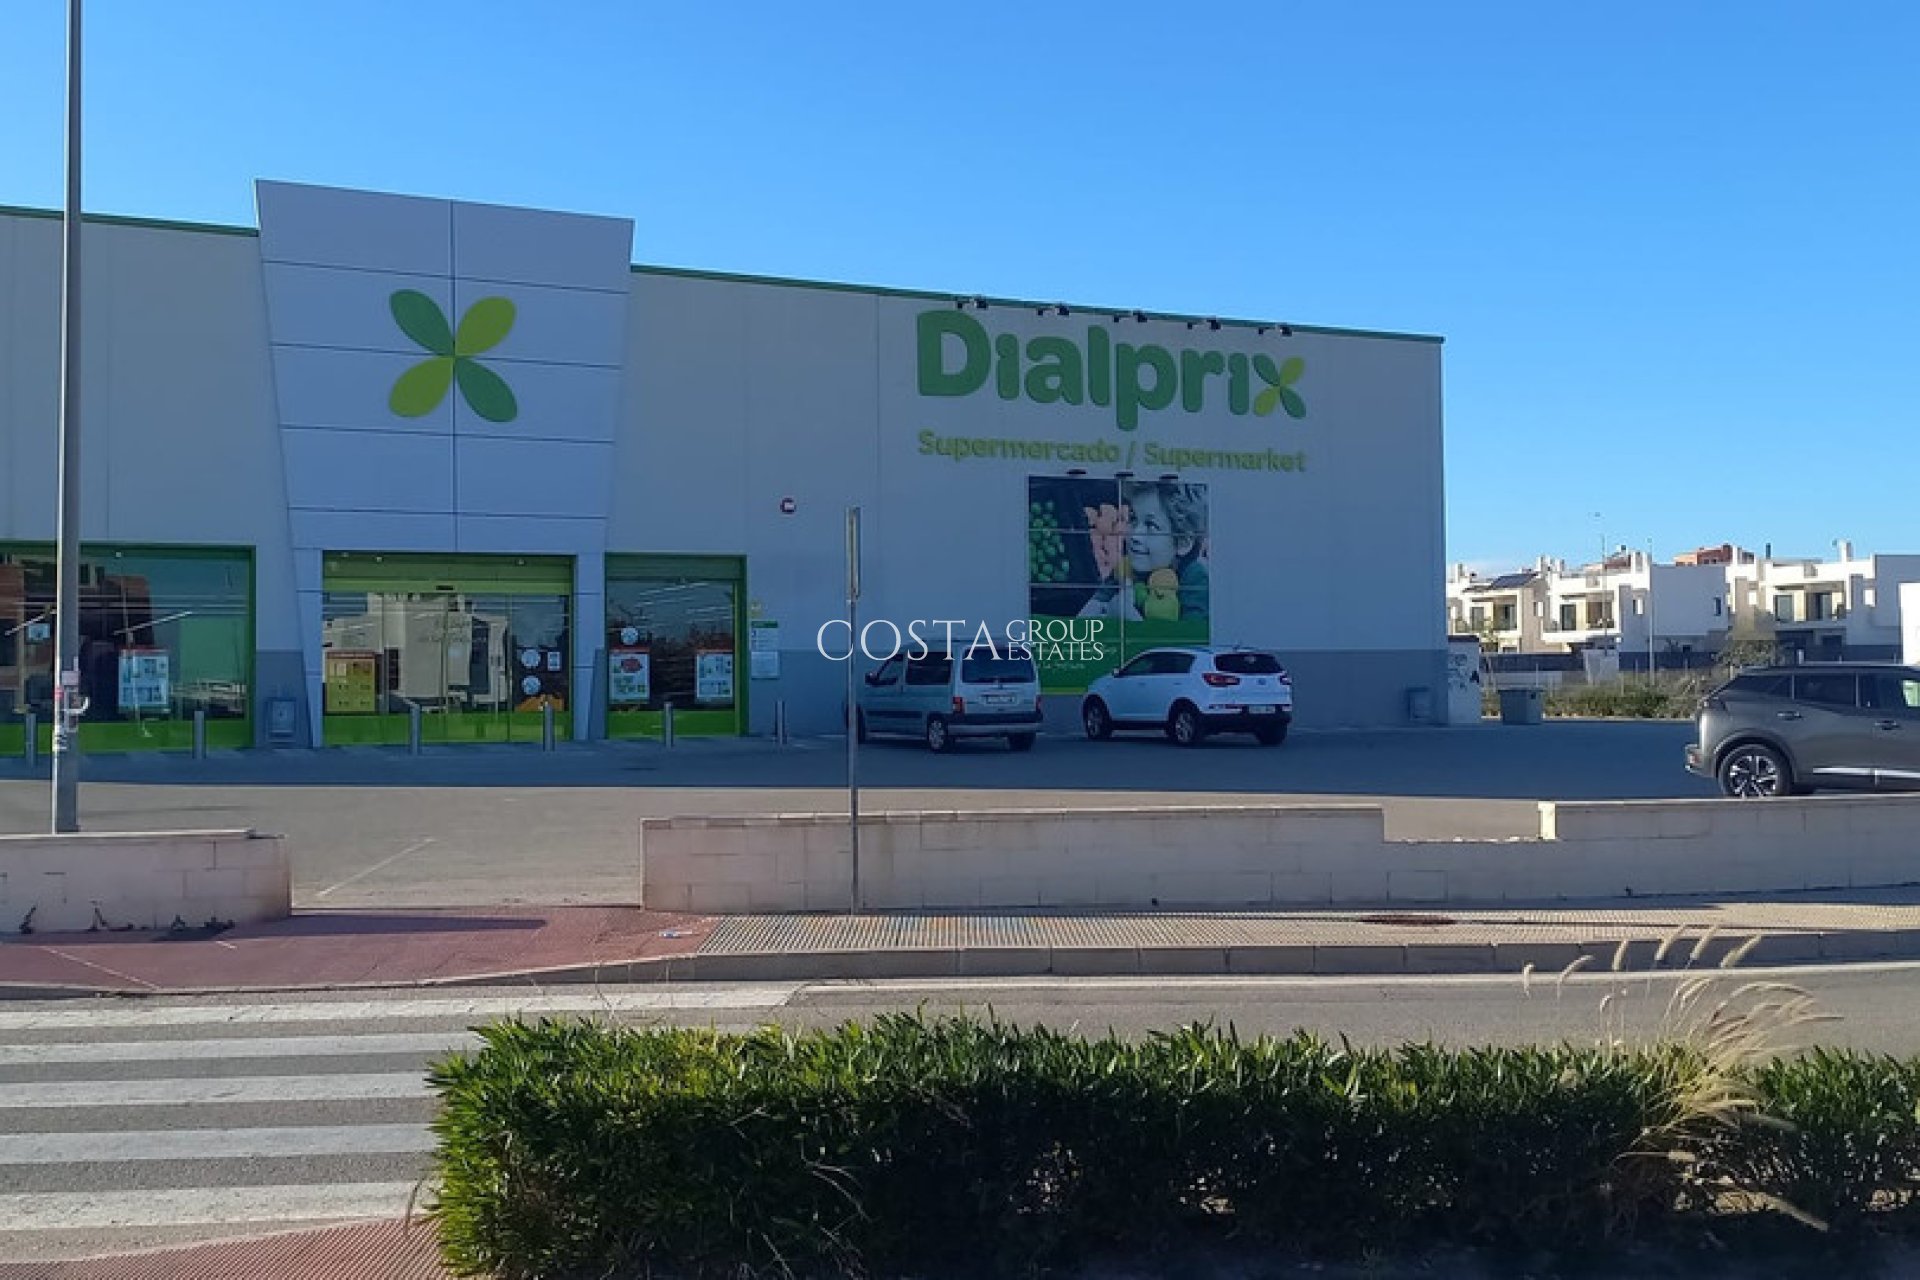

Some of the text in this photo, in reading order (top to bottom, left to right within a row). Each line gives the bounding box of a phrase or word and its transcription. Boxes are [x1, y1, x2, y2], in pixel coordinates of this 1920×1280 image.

[917, 310, 1307, 431] Dialprix
[918, 428, 1121, 463] Supermercado
[1144, 442, 1307, 473] Supermarket
